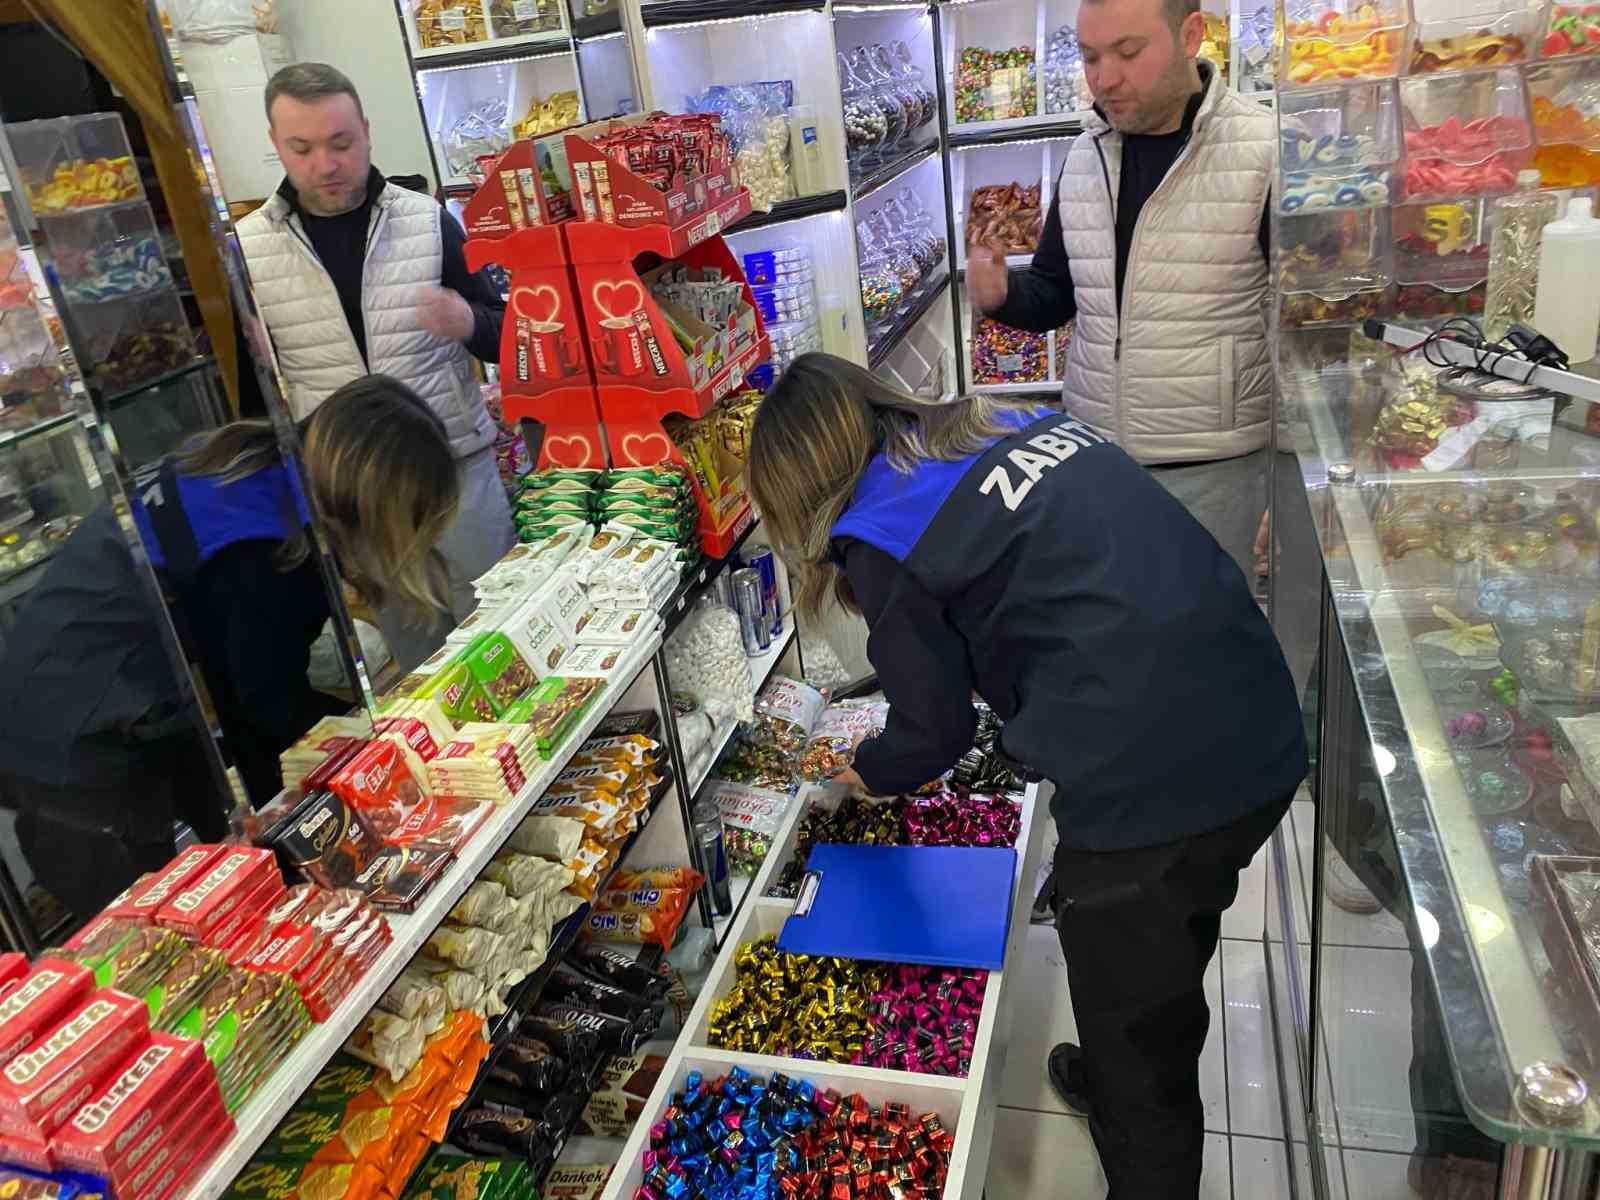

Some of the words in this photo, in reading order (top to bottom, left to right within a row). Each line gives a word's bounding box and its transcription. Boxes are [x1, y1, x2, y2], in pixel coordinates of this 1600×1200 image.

[174, 854, 250, 911] ÜLKER
[0, 970, 64, 1027] KER
[565, 1009, 608, 1031] nero
[5, 1000, 117, 1084] ÜLKER
[74, 1045, 173, 1132] ÜLKER
[549, 1170, 606, 1185] Dankek
